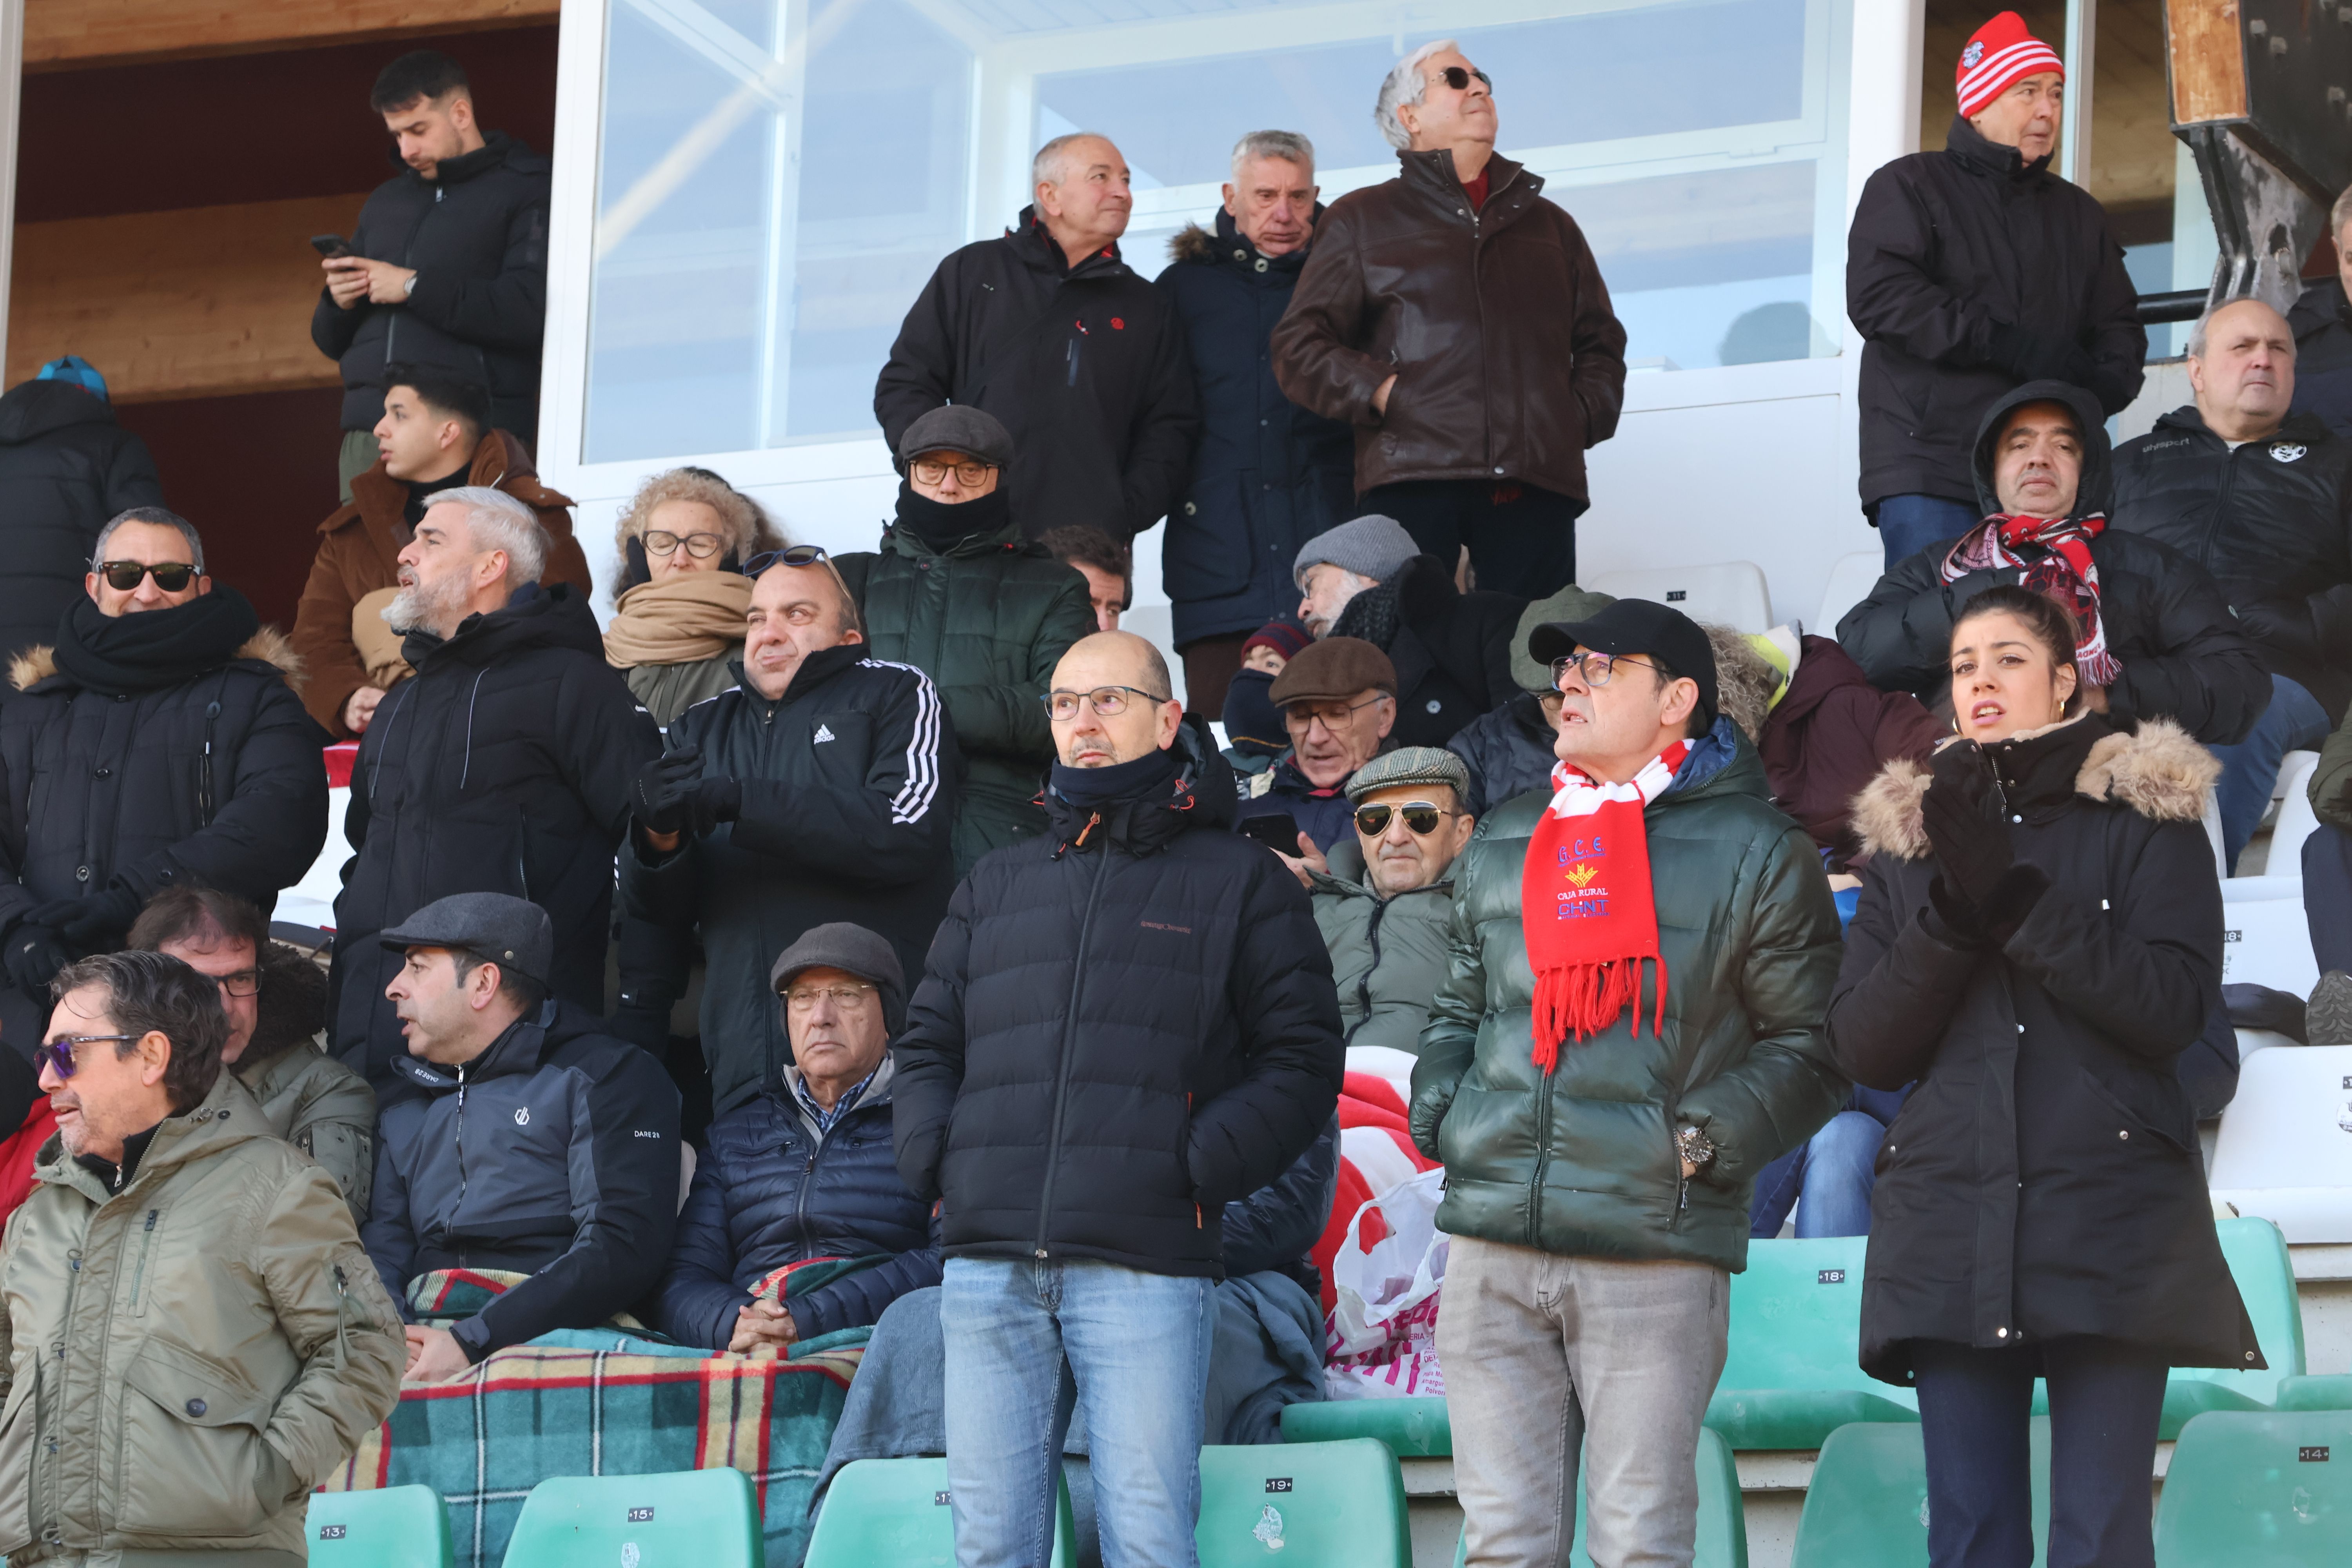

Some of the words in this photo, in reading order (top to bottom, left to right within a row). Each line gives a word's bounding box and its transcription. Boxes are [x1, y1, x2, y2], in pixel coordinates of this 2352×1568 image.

[1557, 890, 1577, 900] CAJA
[1578, 887, 1608, 897] RURAL
[1824, 1272, 1839, 1281] 18
[1421, 1379, 1444, 1387] Amargur
[1425, 1387, 1445, 1396] Polvori
[2305, 1449, 2322, 1459] 14
[1271, 1481, 1286, 1490] 19
[633, 1510, 647, 1519] 15
[326, 1527, 339, 1537] 13
